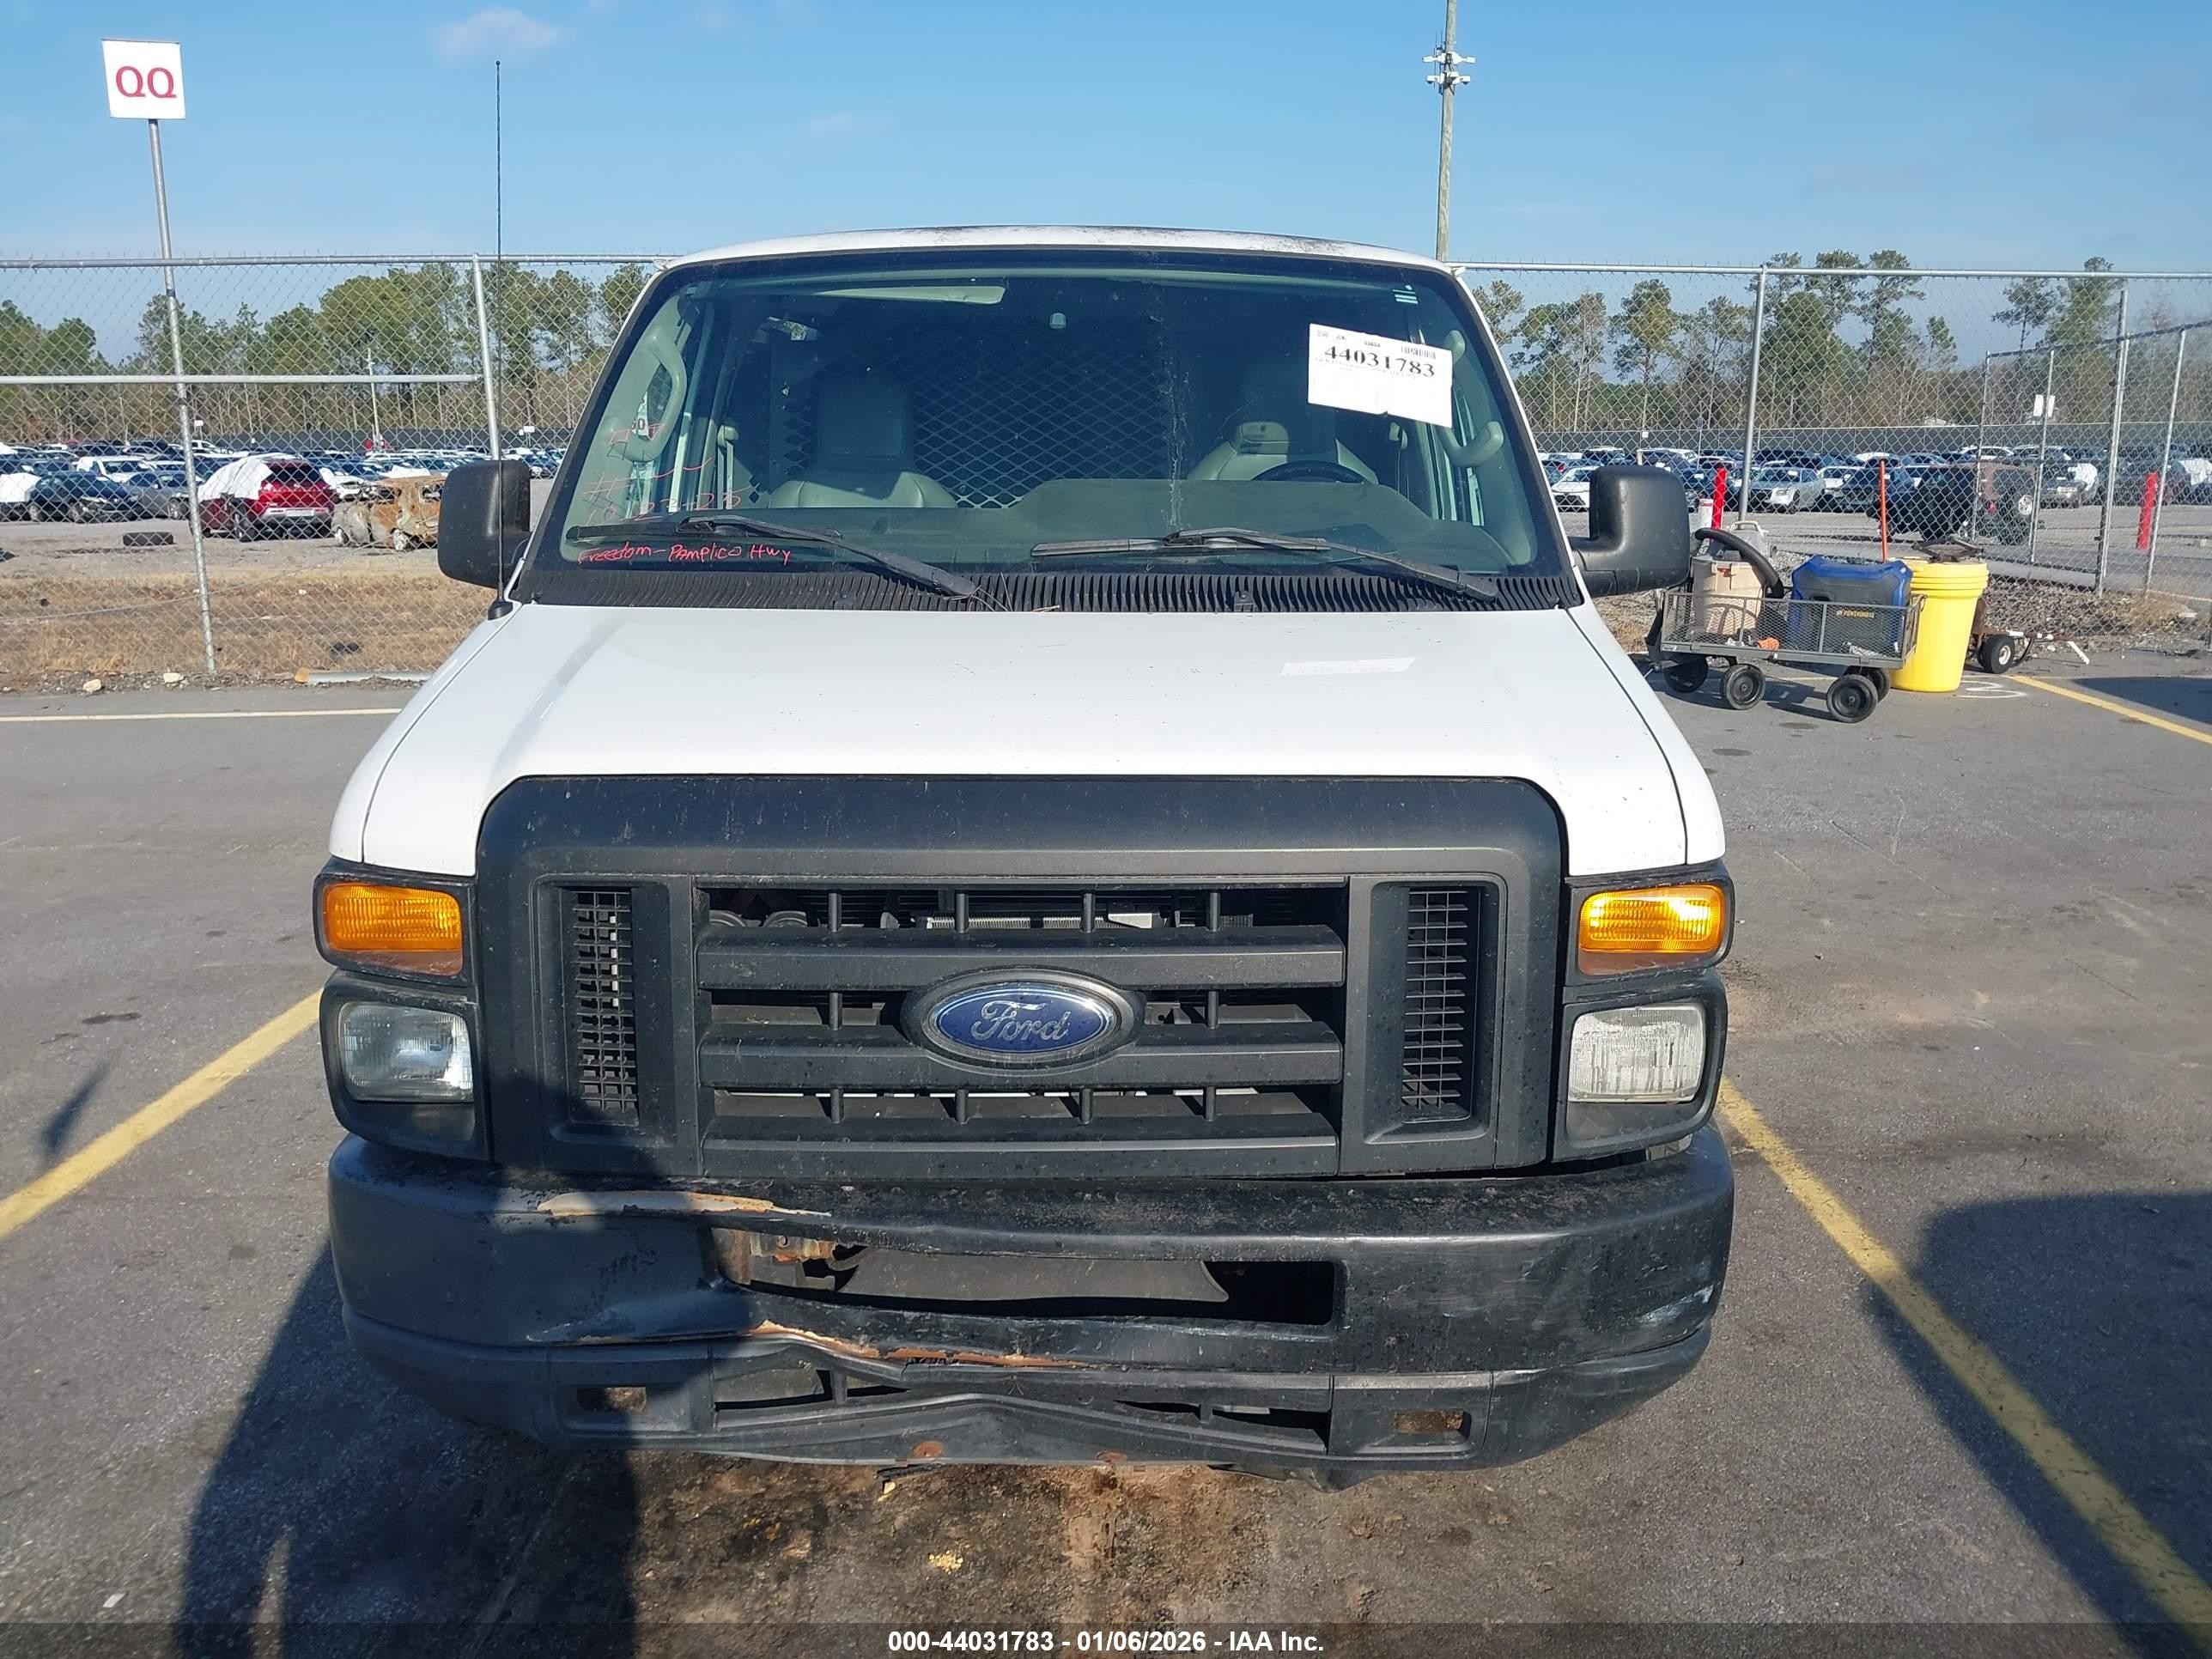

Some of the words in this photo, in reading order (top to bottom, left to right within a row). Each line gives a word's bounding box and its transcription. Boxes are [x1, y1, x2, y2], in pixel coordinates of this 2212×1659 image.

[115, 65, 177, 99] QQ
[1324, 345, 1436, 378] 44031783
[750, 544, 791, 566] Hwy
[970, 1000, 1072, 1041] Ford
